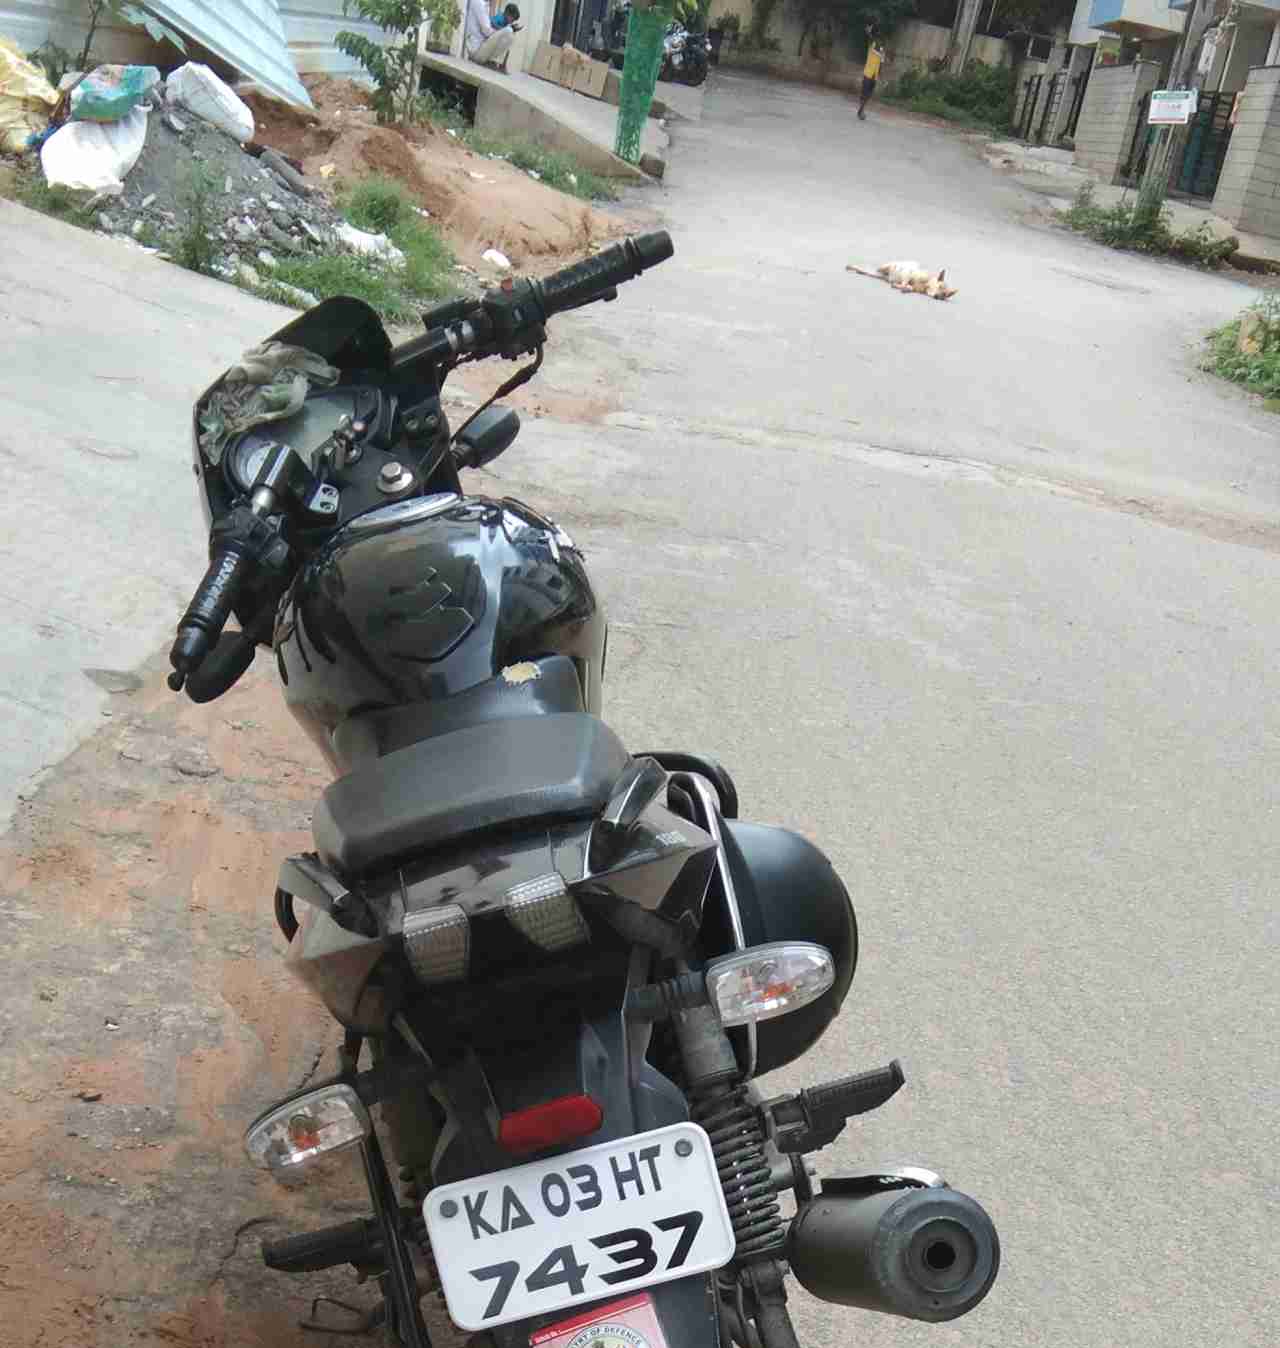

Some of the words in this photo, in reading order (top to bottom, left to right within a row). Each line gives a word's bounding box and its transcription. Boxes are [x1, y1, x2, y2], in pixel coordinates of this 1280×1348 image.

[463, 1185, 535, 1239] KA
[540, 1164, 602, 1217] 03
[610, 1144, 662, 1200] HT
[468, 1210, 704, 1320] 7437
